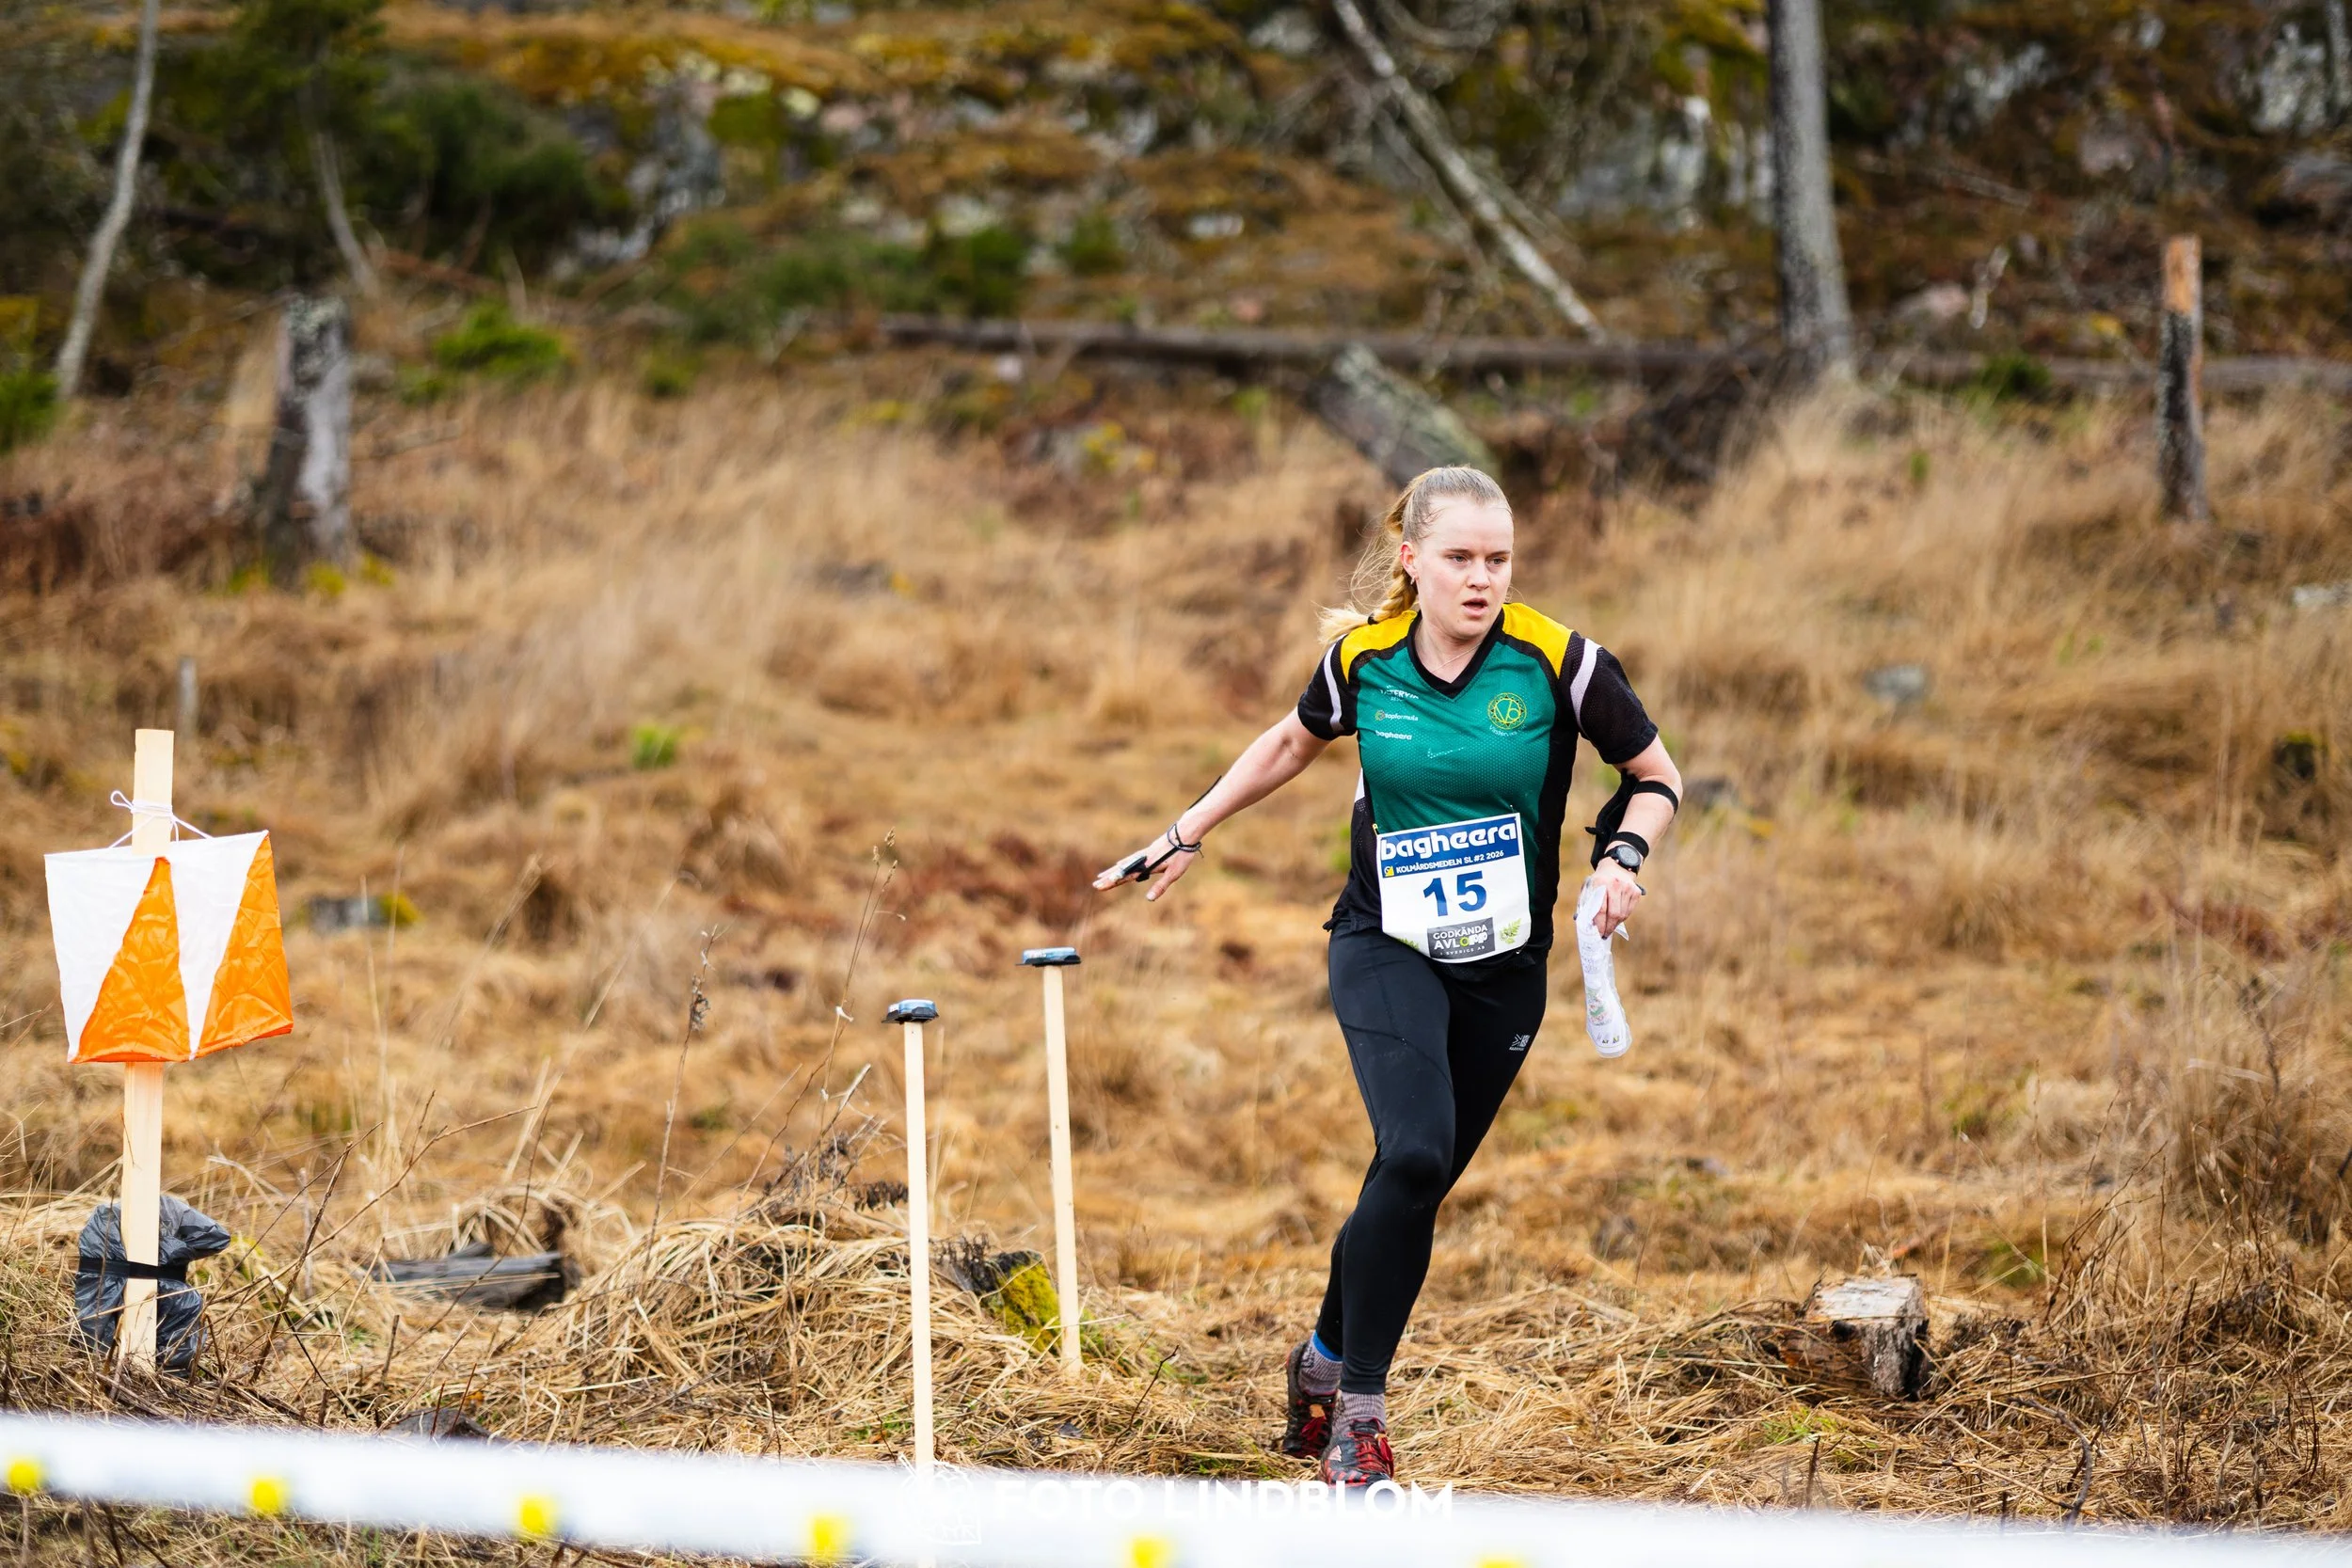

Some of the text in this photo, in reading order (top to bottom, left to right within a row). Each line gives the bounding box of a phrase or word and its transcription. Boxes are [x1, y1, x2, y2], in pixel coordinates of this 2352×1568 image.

[1375, 730, 1413, 740] bagheera
[1380, 822, 1518, 861] bagheera
[1395, 858, 1463, 874] KOLMÅRDSMEDELN
[1473, 853, 1486, 863] #2
[1486, 850, 1504, 860] 2026
[1422, 870, 1487, 917] 15
[1433, 924, 1488, 940] GODKÄNDA
